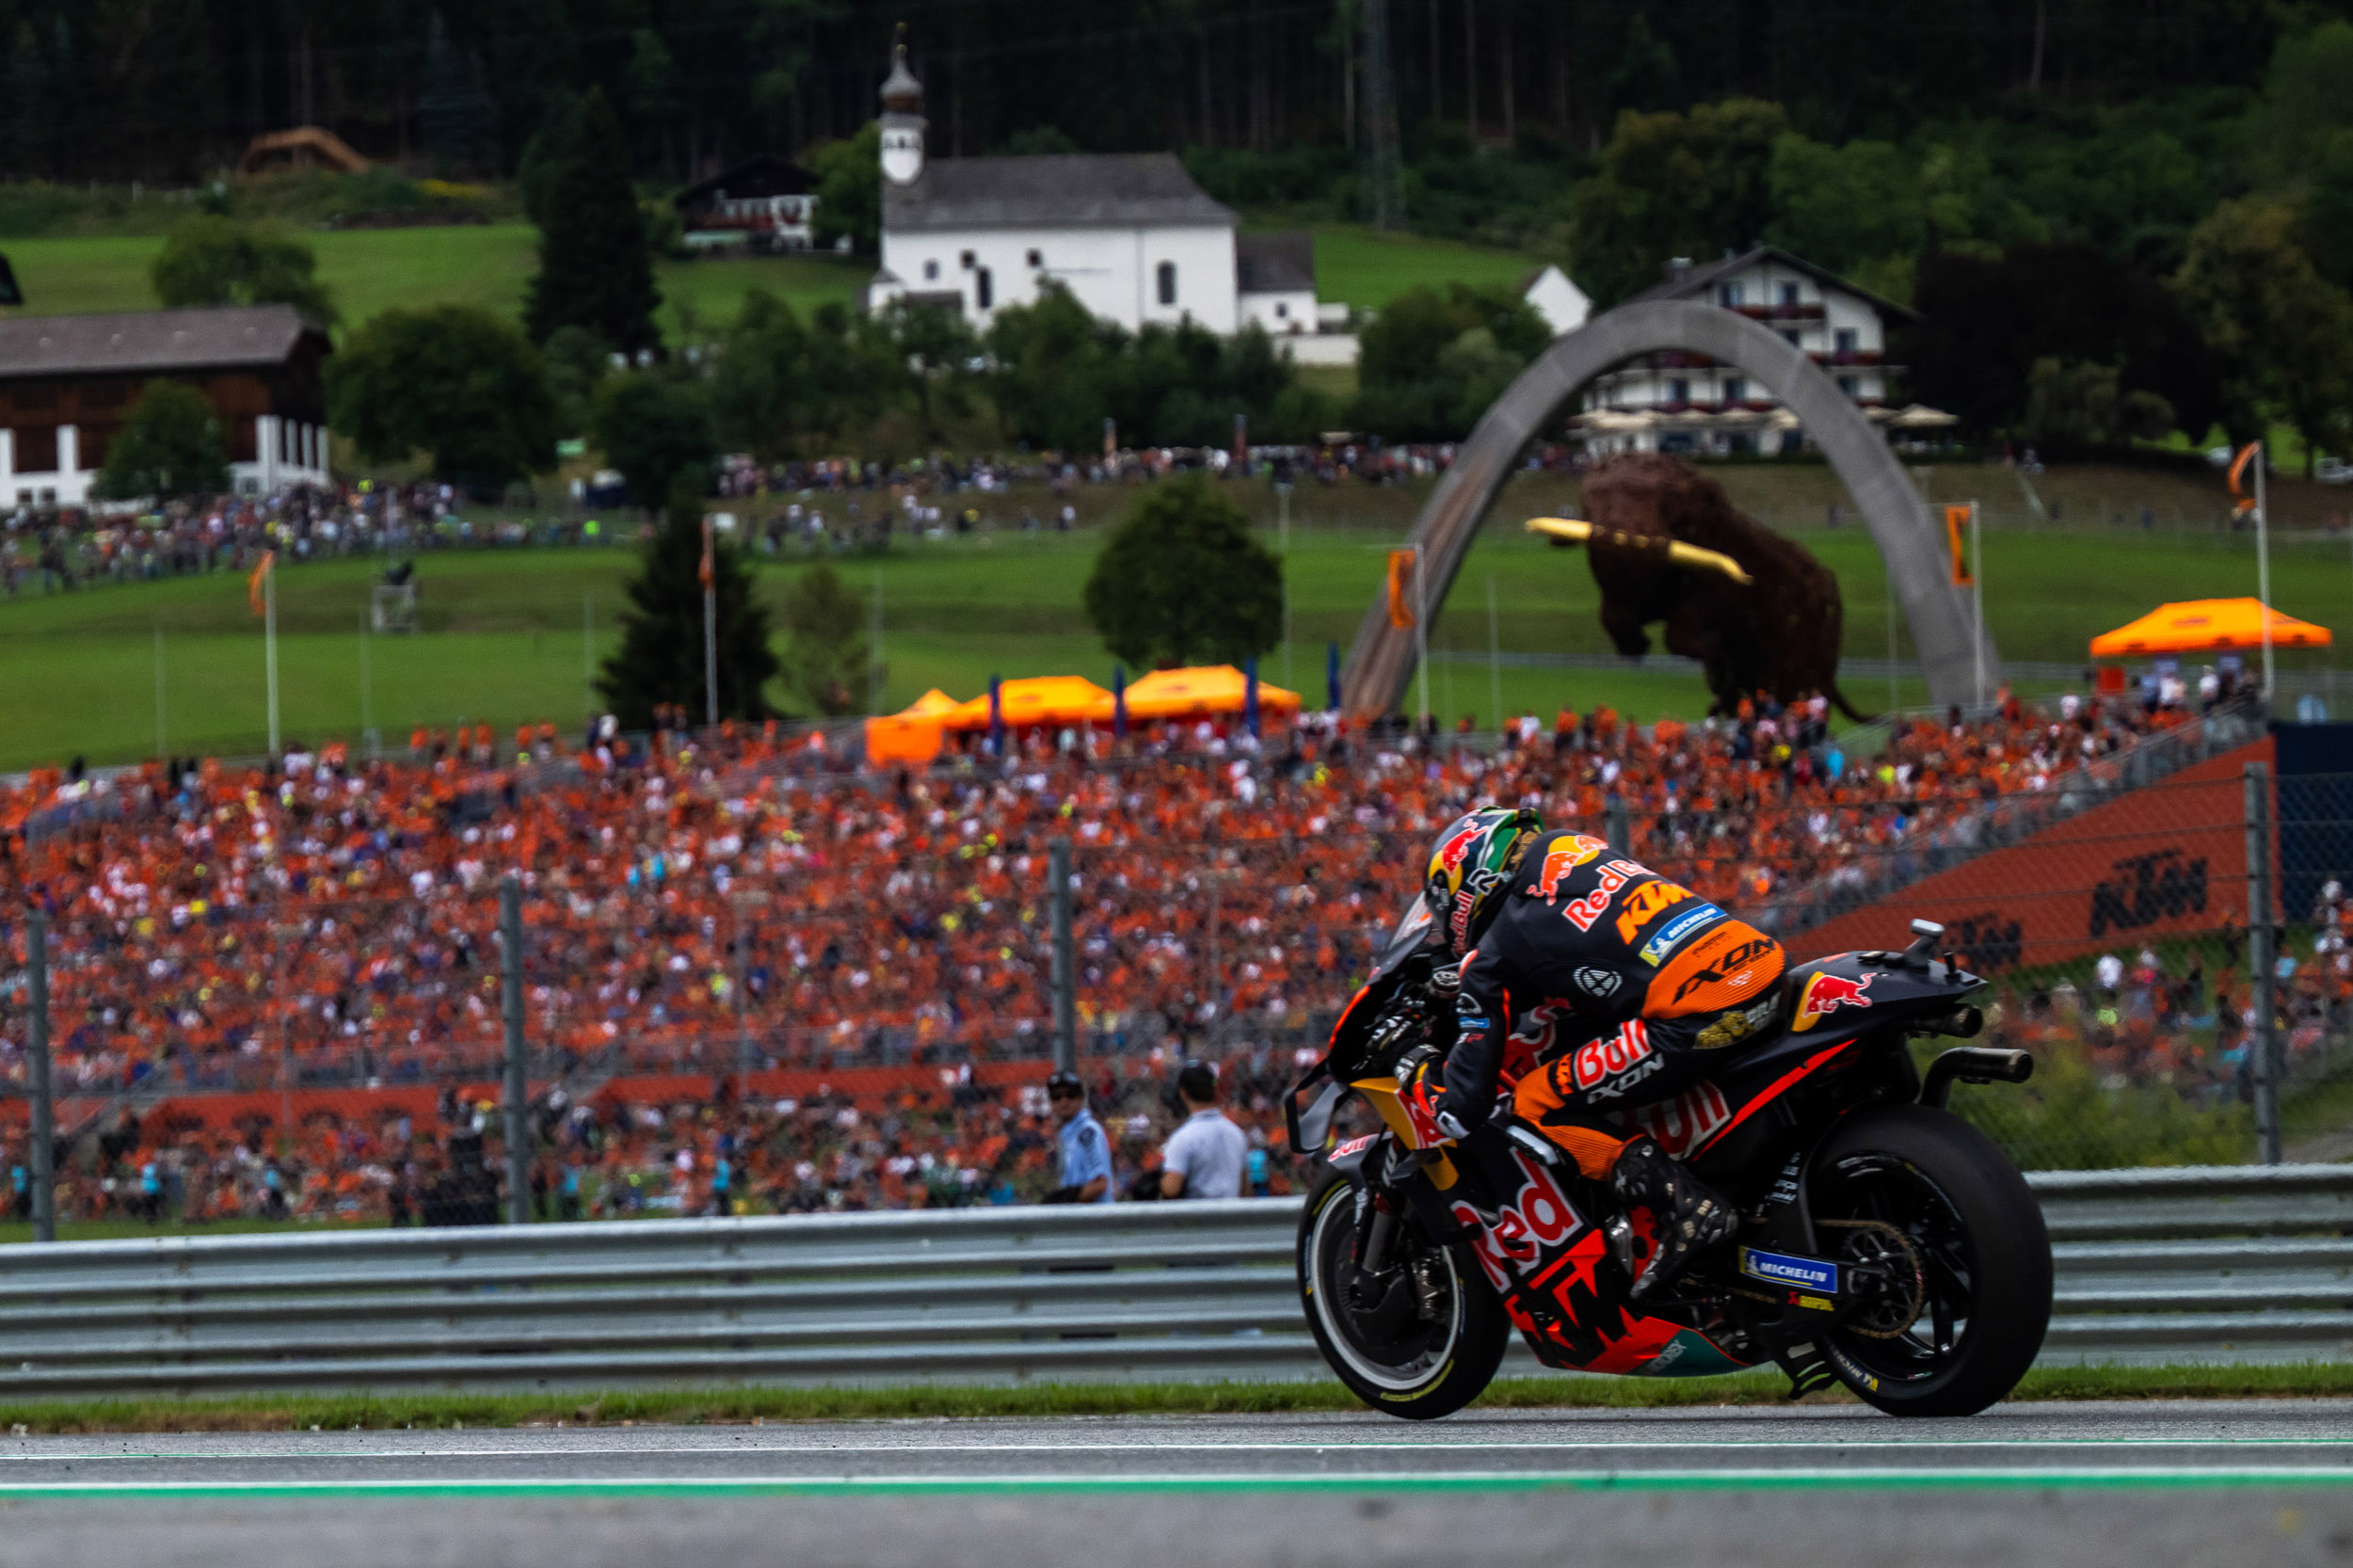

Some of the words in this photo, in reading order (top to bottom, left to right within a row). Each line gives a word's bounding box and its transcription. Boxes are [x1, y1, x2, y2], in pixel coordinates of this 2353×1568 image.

[1450, 889, 1476, 928] Bull
[1561, 865, 1630, 933] Red
[1615, 880, 1695, 945] KTM
[2090, 849, 2208, 939] KTM
[1932, 910, 2022, 969] TM
[1574, 1017, 1653, 1091] Bull
[1606, 1080, 1732, 1161] ull
[1449, 1146, 1584, 1295] Red
[1759, 1262, 1828, 1282] MICHELIN
